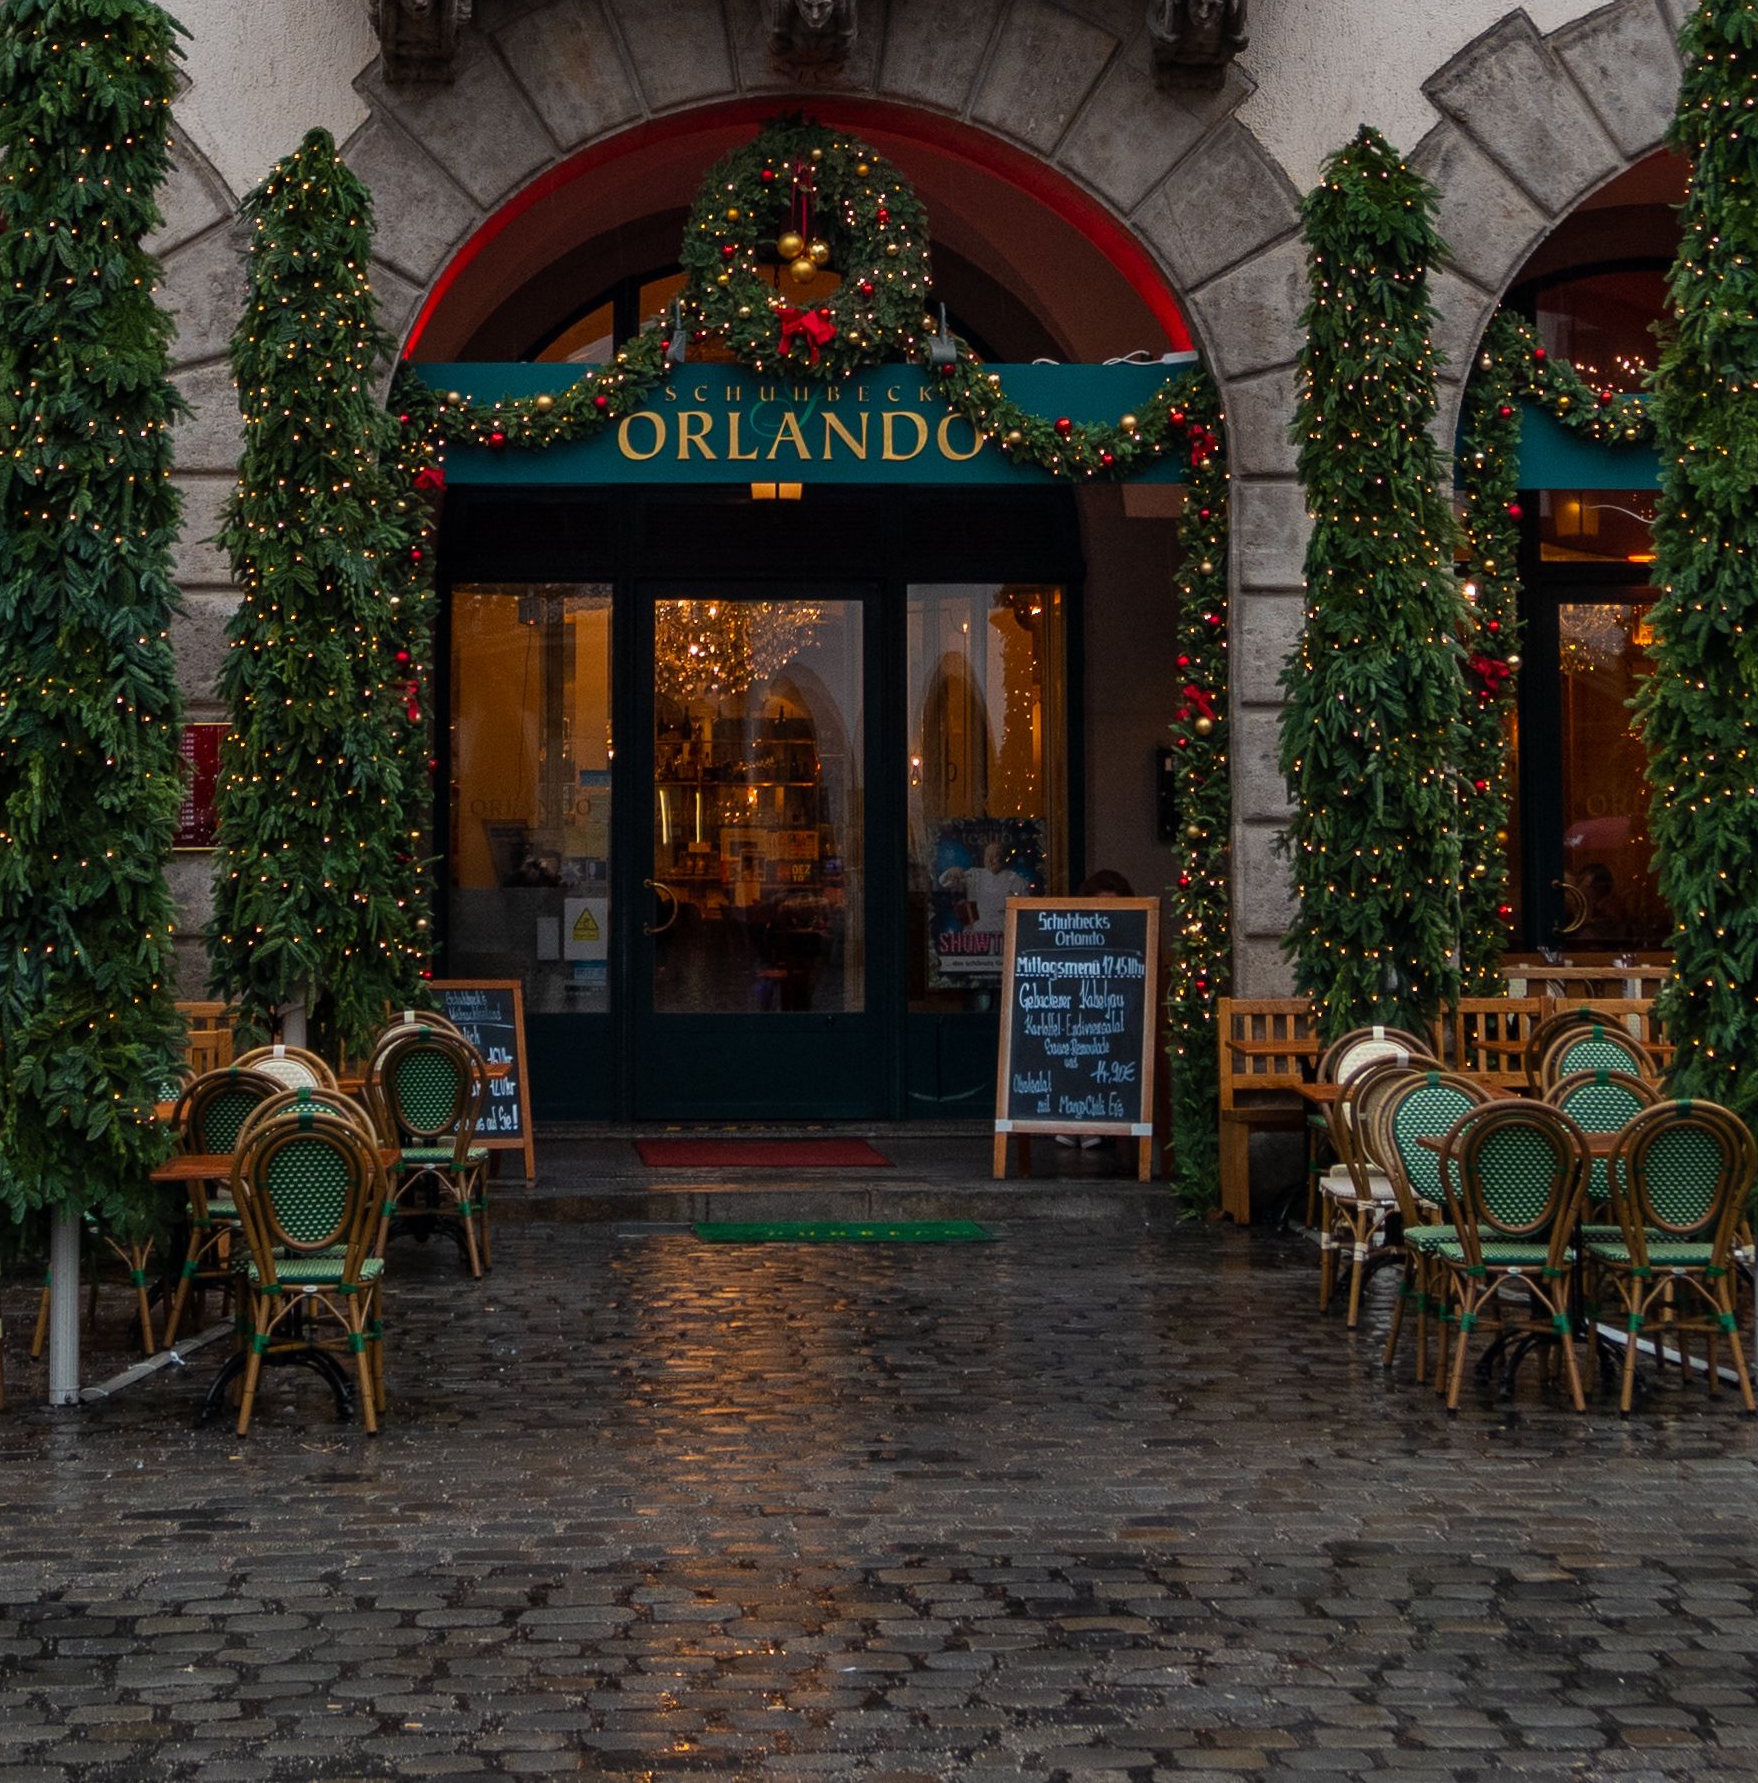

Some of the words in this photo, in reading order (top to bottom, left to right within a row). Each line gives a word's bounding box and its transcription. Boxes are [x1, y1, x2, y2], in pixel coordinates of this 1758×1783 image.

[665, 385, 934, 402] SCHUHBECK
[617, 411, 985, 461] ORLANDO
[1038, 912, 1110, 930] Schuhbecks
[1055, 931, 1105, 946] Orlando
[1017, 956, 1101, 981] Mittagsmenü
[1079, 979, 1124, 1019] Kabeljau
